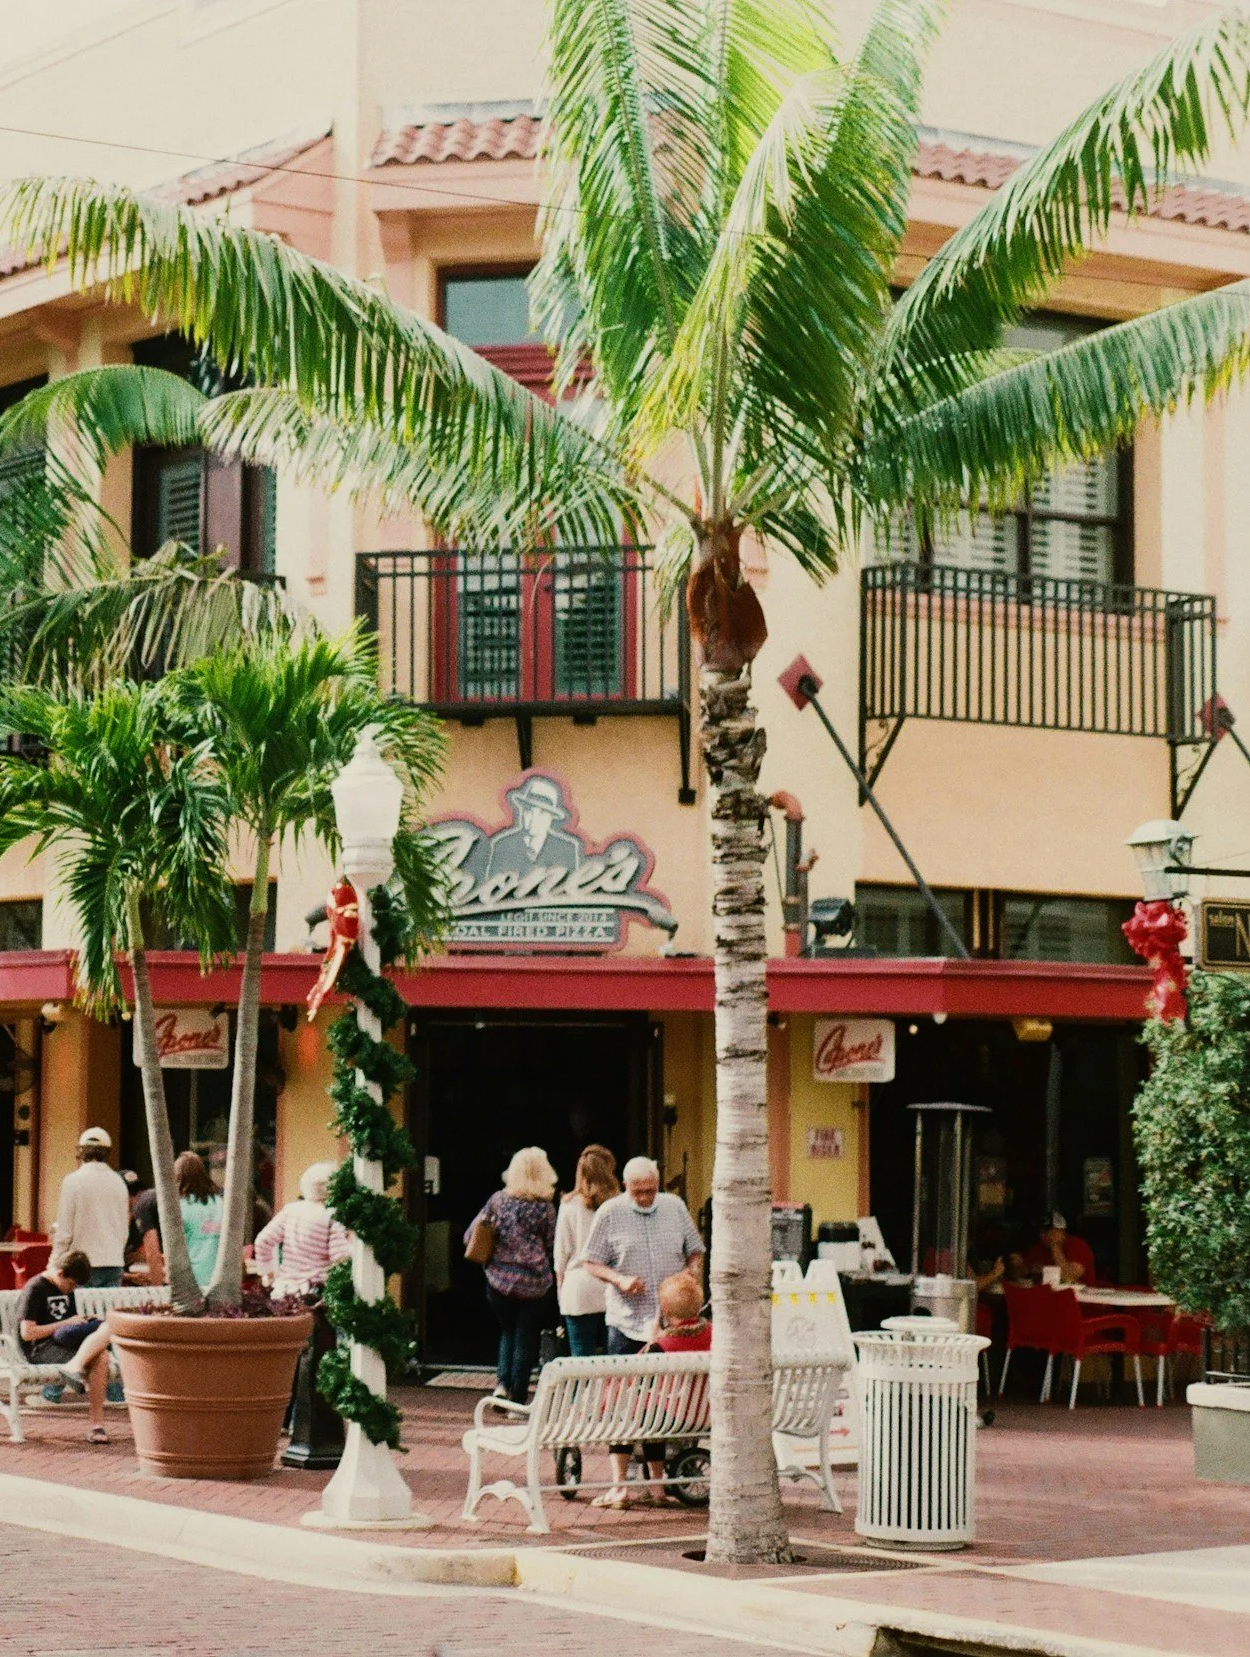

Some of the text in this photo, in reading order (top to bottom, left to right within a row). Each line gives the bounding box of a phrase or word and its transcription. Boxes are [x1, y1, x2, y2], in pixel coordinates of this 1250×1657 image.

[447, 925, 607, 938] OAL FIRED PIZZA
